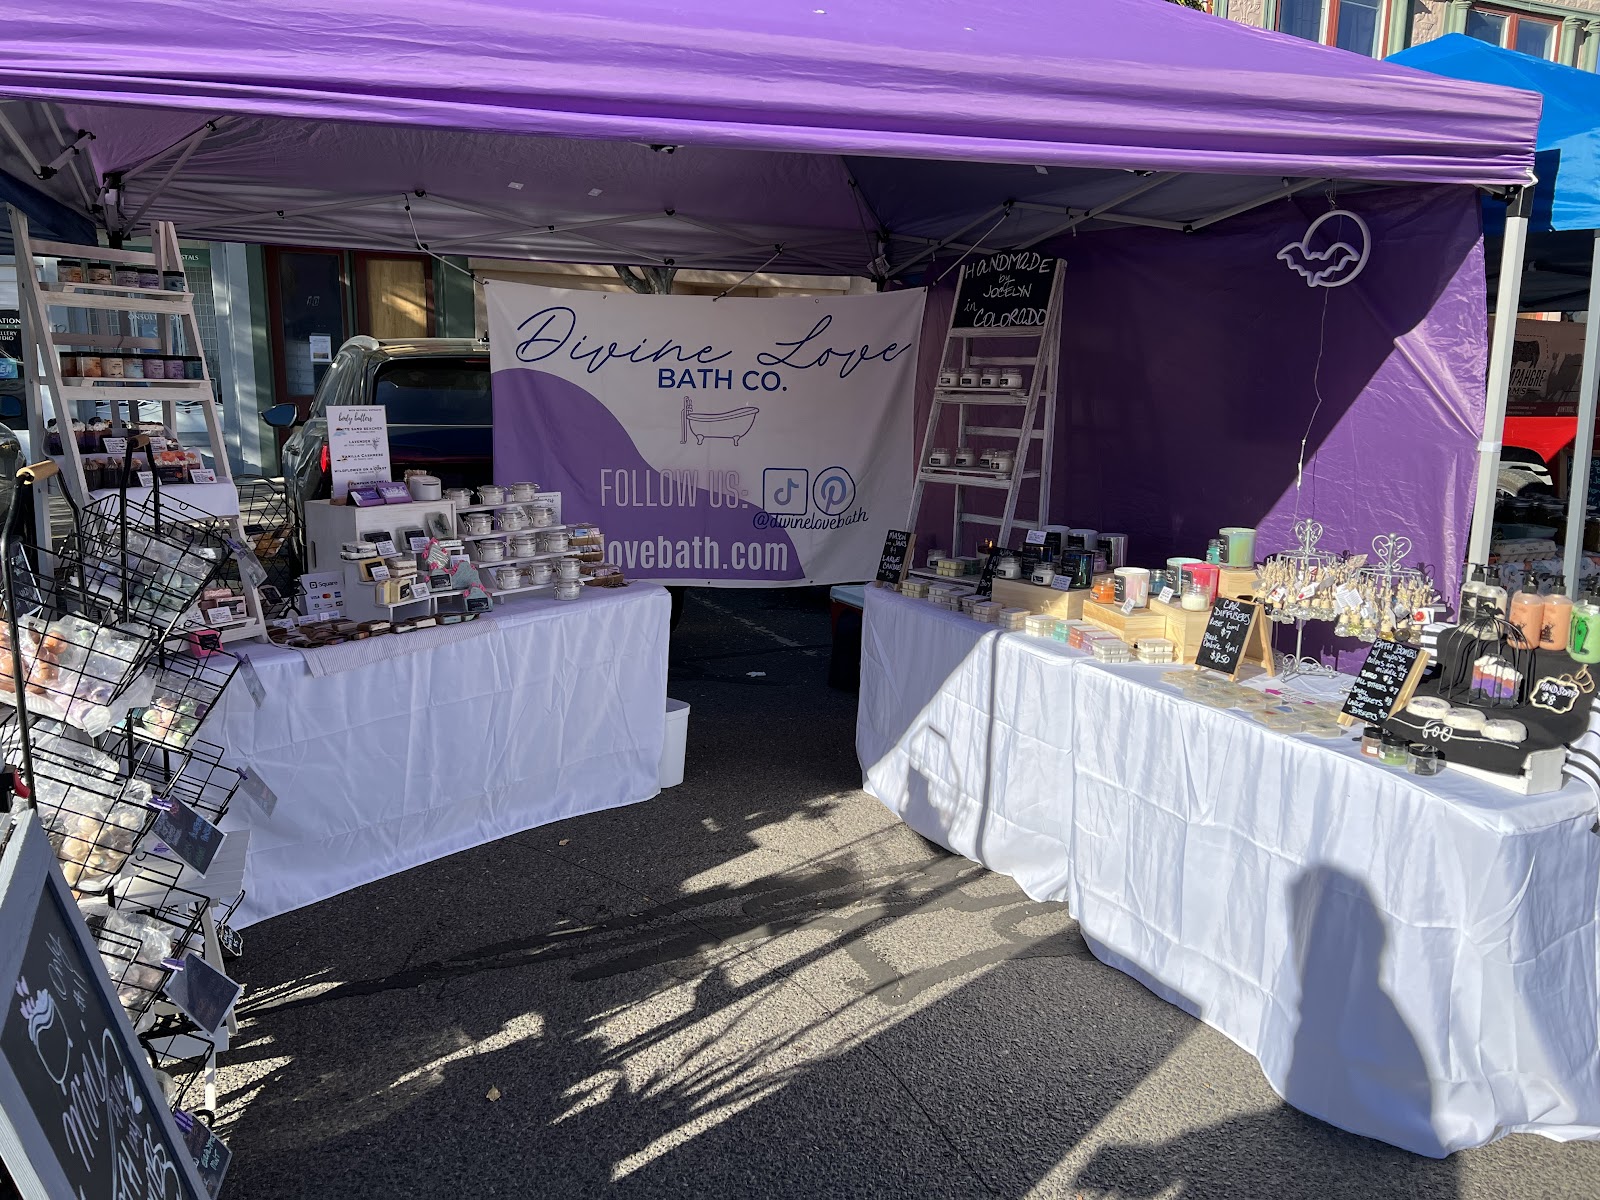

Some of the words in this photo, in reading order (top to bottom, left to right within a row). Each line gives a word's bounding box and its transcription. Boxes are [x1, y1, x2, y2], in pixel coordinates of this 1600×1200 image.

[516, 306, 732, 373] Divine
[757, 315, 911, 378] Love
[658, 368, 732, 390] BATH
[742, 370, 788, 391] CO.
[600, 468, 698, 507] FOLLOW
[709, 470, 749, 509] US:
[752, 506, 869, 530] @divinelovebath
